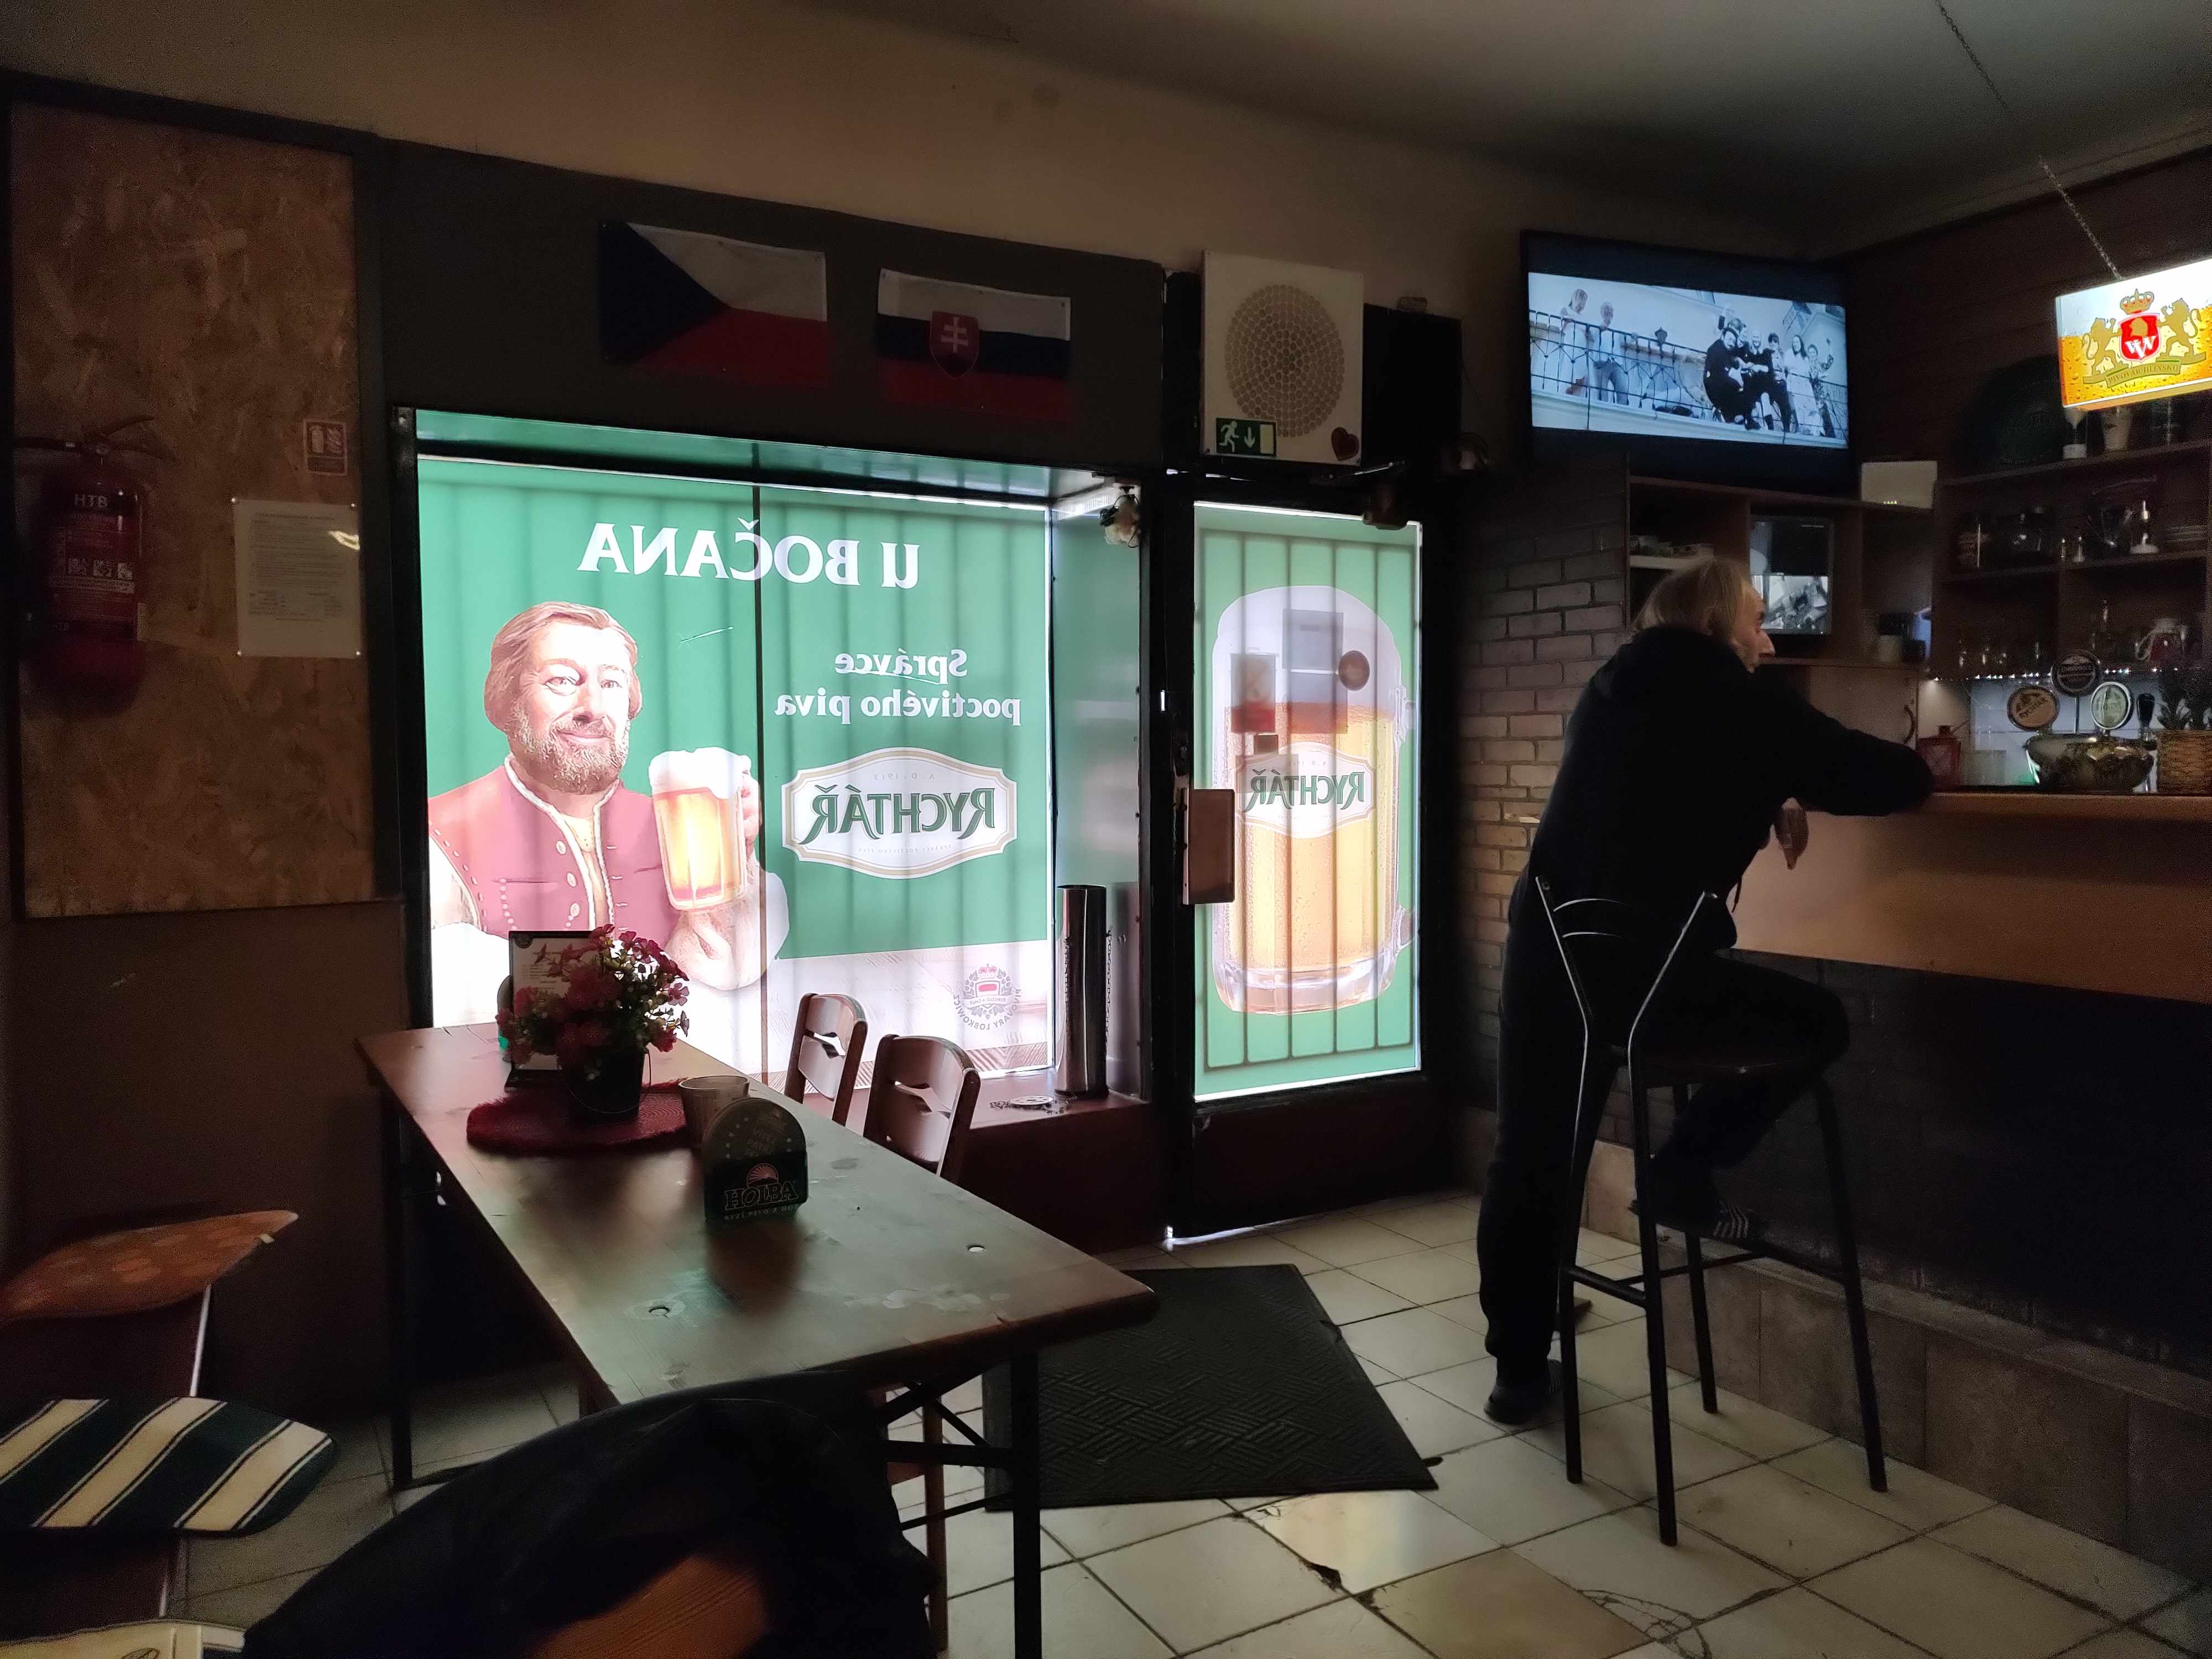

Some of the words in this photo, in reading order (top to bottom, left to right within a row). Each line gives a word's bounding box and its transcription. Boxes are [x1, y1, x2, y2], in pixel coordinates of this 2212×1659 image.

[2108, 368, 2141, 384] PIVOVAR
[2143, 364, 2179, 373] HLINSKO
[74, 493, 108, 508] HTB
[724, 1180, 799, 1211] HOLBA
